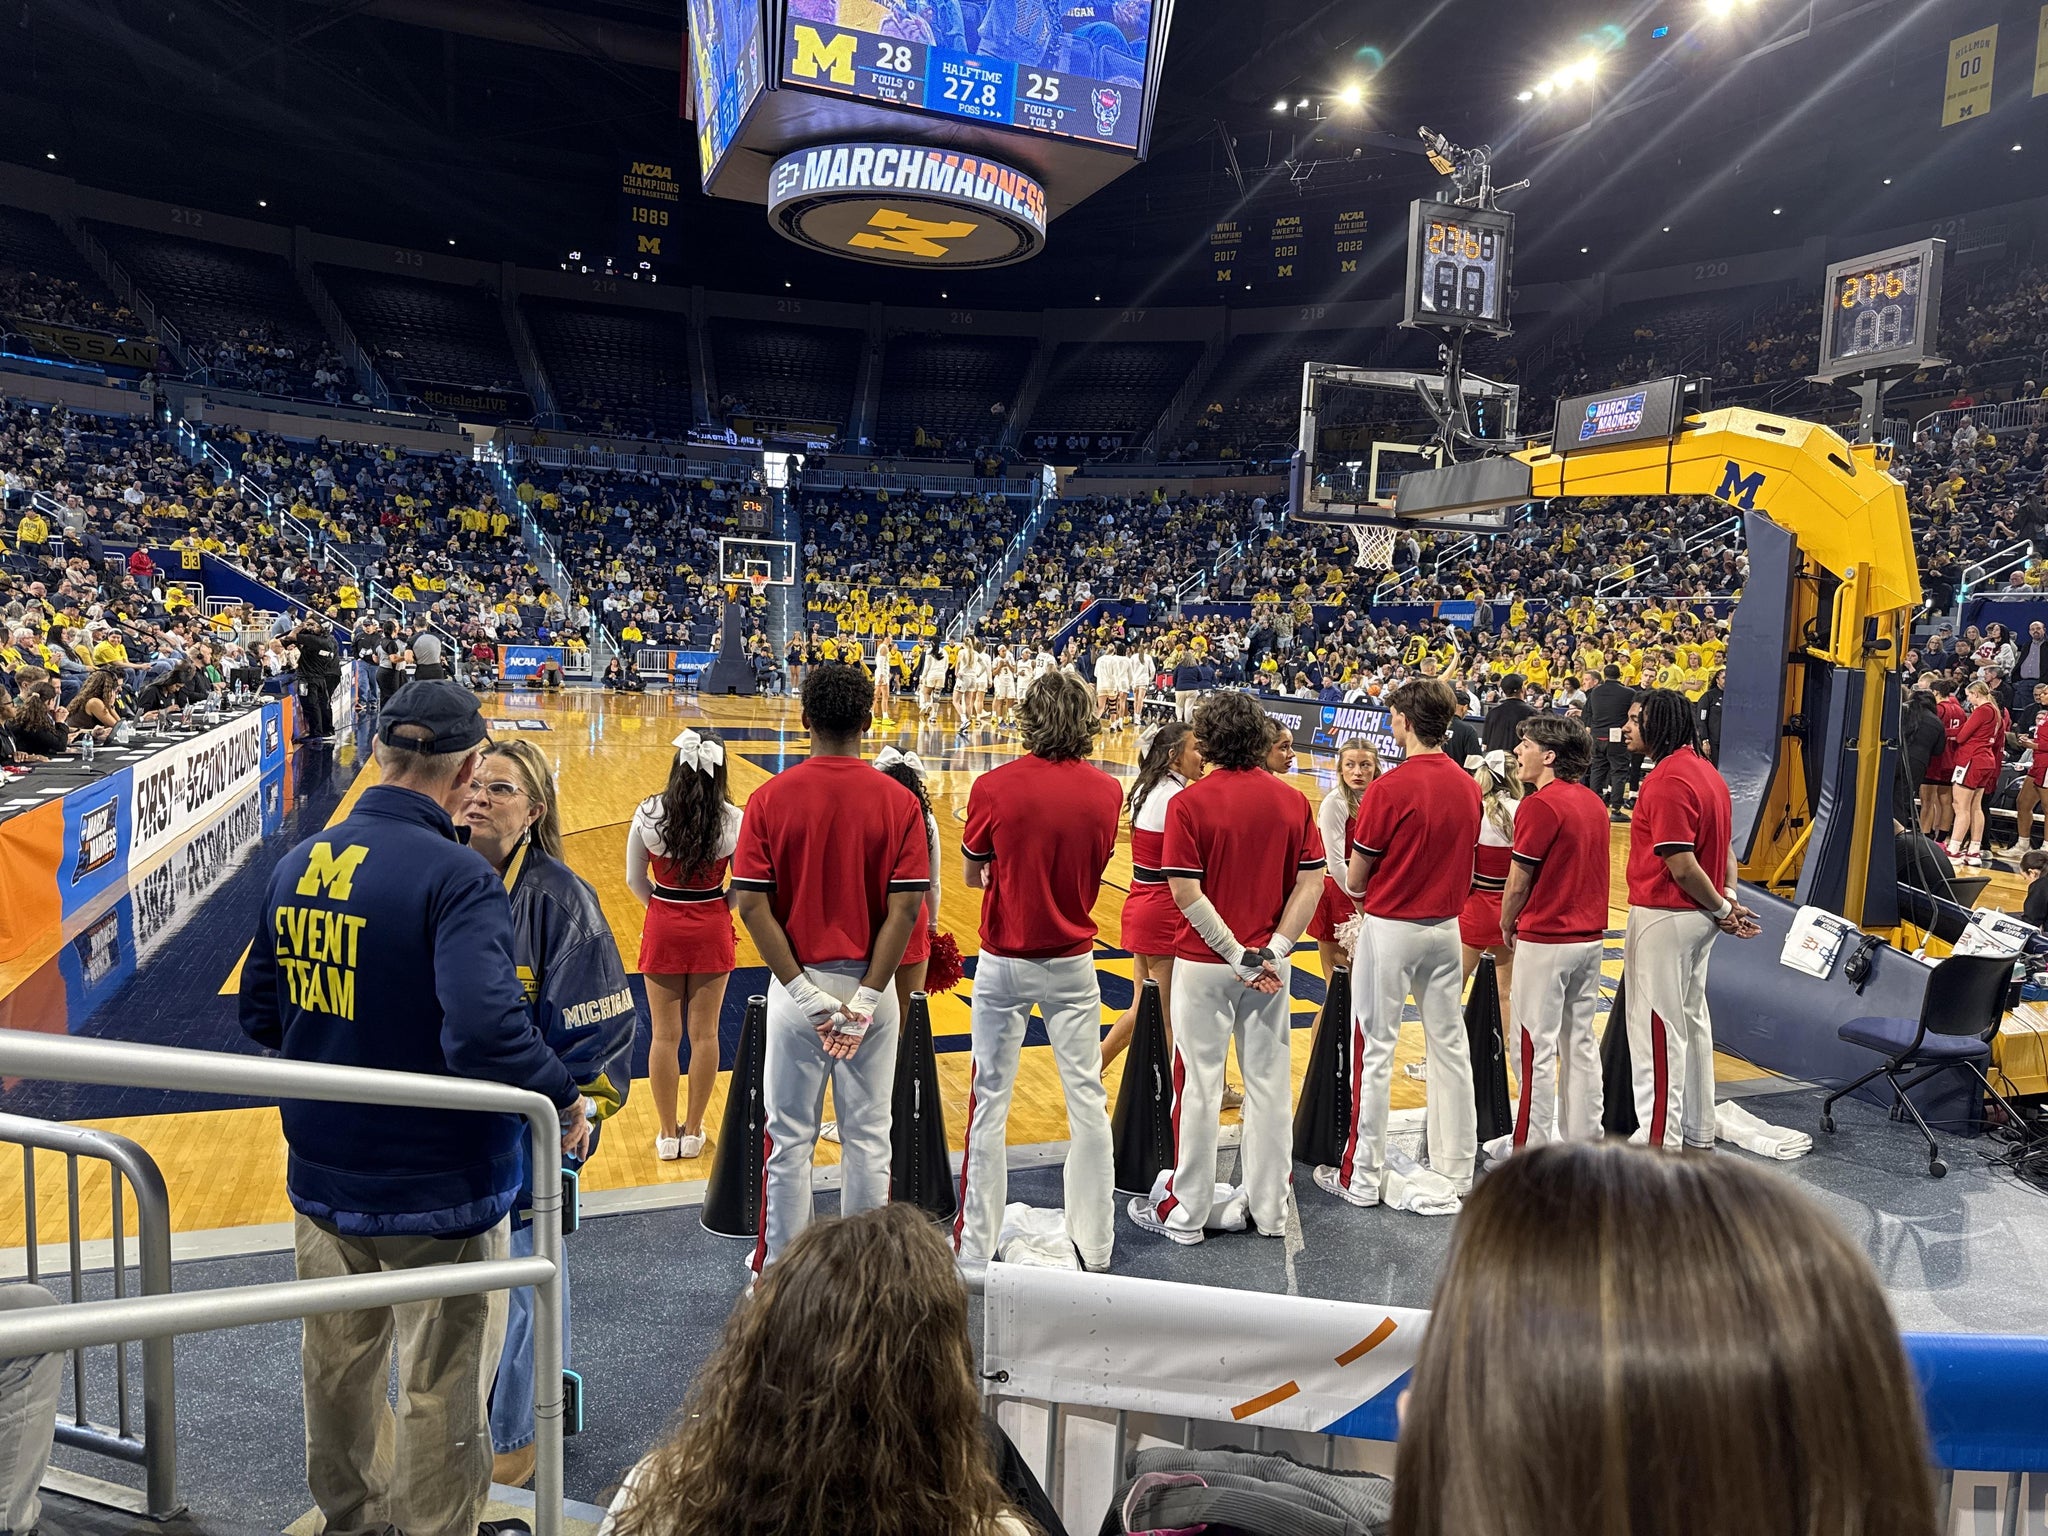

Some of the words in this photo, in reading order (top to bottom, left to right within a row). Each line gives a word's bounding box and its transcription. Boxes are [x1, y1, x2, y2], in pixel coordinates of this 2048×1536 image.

[792, 24, 858, 86] M
[875, 42, 912, 73] 28
[942, 62, 1003, 85] HALFTIME
[1960, 56, 1981, 79] 00
[871, 73, 903, 88] FOULS
[907, 80, 915, 90] 0
[1026, 73, 1060, 102] 25
[877, 87, 898, 99] TOL
[900, 90, 907, 101] 4
[943, 76, 997, 107] 27.8
[958, 103, 980, 116] POSS
[1024, 104, 1053, 117] FOULS
[1056, 110, 1064, 119] 0
[1029, 116, 1047, 128] TOL
[1050, 119, 1057, 130] 3
[631, 161, 672, 180] NCAA
[623, 174, 680, 193] CHAMPIONS
[171, 208, 202, 228] 212
[632, 206, 669, 226] 1989
[1275, 216, 1300, 227] NCAA
[1339, 210, 1364, 222] NCAA
[1210, 231, 1243, 241] CHAMPIONS
[1216, 222, 1237, 232] WNIT
[1272, 227, 1294, 236] SWEET
[638, 235, 661, 255] M
[1275, 245, 1298, 258] 2021
[1337, 240, 1363, 253] 2022
[394, 250, 424, 268] 213
[1214, 251, 1237, 262] 2017
[1341, 259, 1357, 272] M
[1216, 269, 1232, 281] M
[1277, 264, 1293, 277] M
[1696, 262, 1729, 280] 220
[592, 280, 617, 294] 214
[777, 299, 802, 314] 215
[1301, 306, 1325, 321] 218
[950, 311, 974, 325] 216
[1121, 309, 1147, 324] 217
[424, 390, 507, 411] #CrislerLIVE
[1595, 399, 1629, 418] MARCH
[1597, 410, 1642, 430] MADNESS
[1875, 446, 1890, 461] M
[1715, 460, 1766, 509] M
[1332, 707, 1383, 732] MARCH
[134, 764, 175, 848] FIRST
[186, 740, 227, 813] SECOND
[228, 723, 260, 786] ROUNDS
[295, 842, 370, 901] M
[275, 906, 367, 968] EVENT
[277, 957, 355, 1021] TEAM
[562, 987, 635, 1030] MICHIGAN
